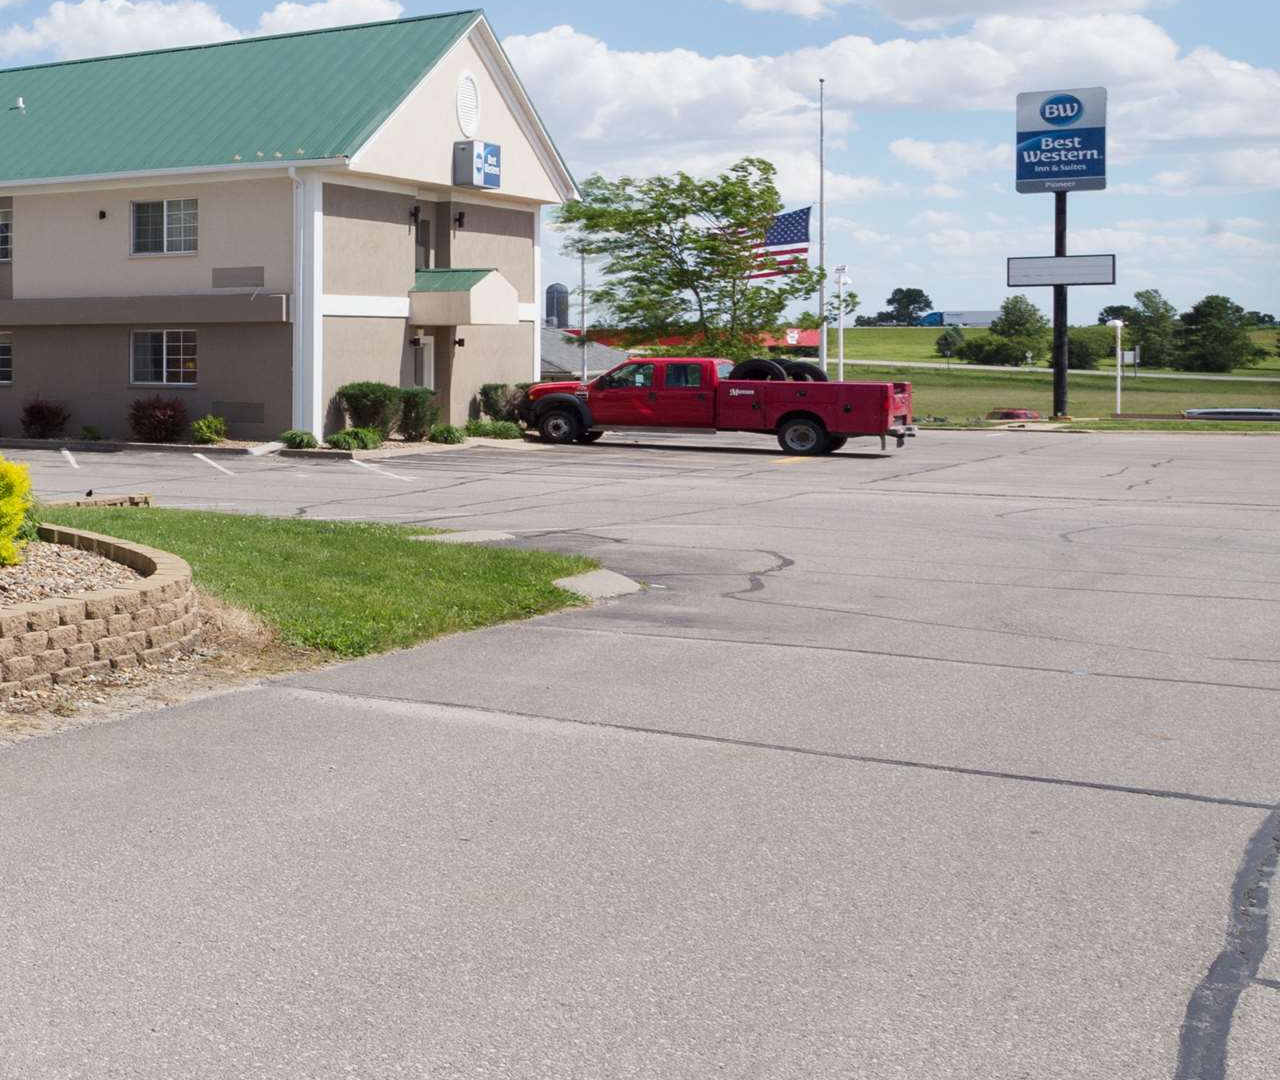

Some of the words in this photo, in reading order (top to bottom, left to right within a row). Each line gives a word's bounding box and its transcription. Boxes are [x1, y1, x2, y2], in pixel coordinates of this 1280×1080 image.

[1044, 103, 1079, 118] BW
[1041, 136, 1082, 150] Best
[1059, 163, 1087, 171] Suites
